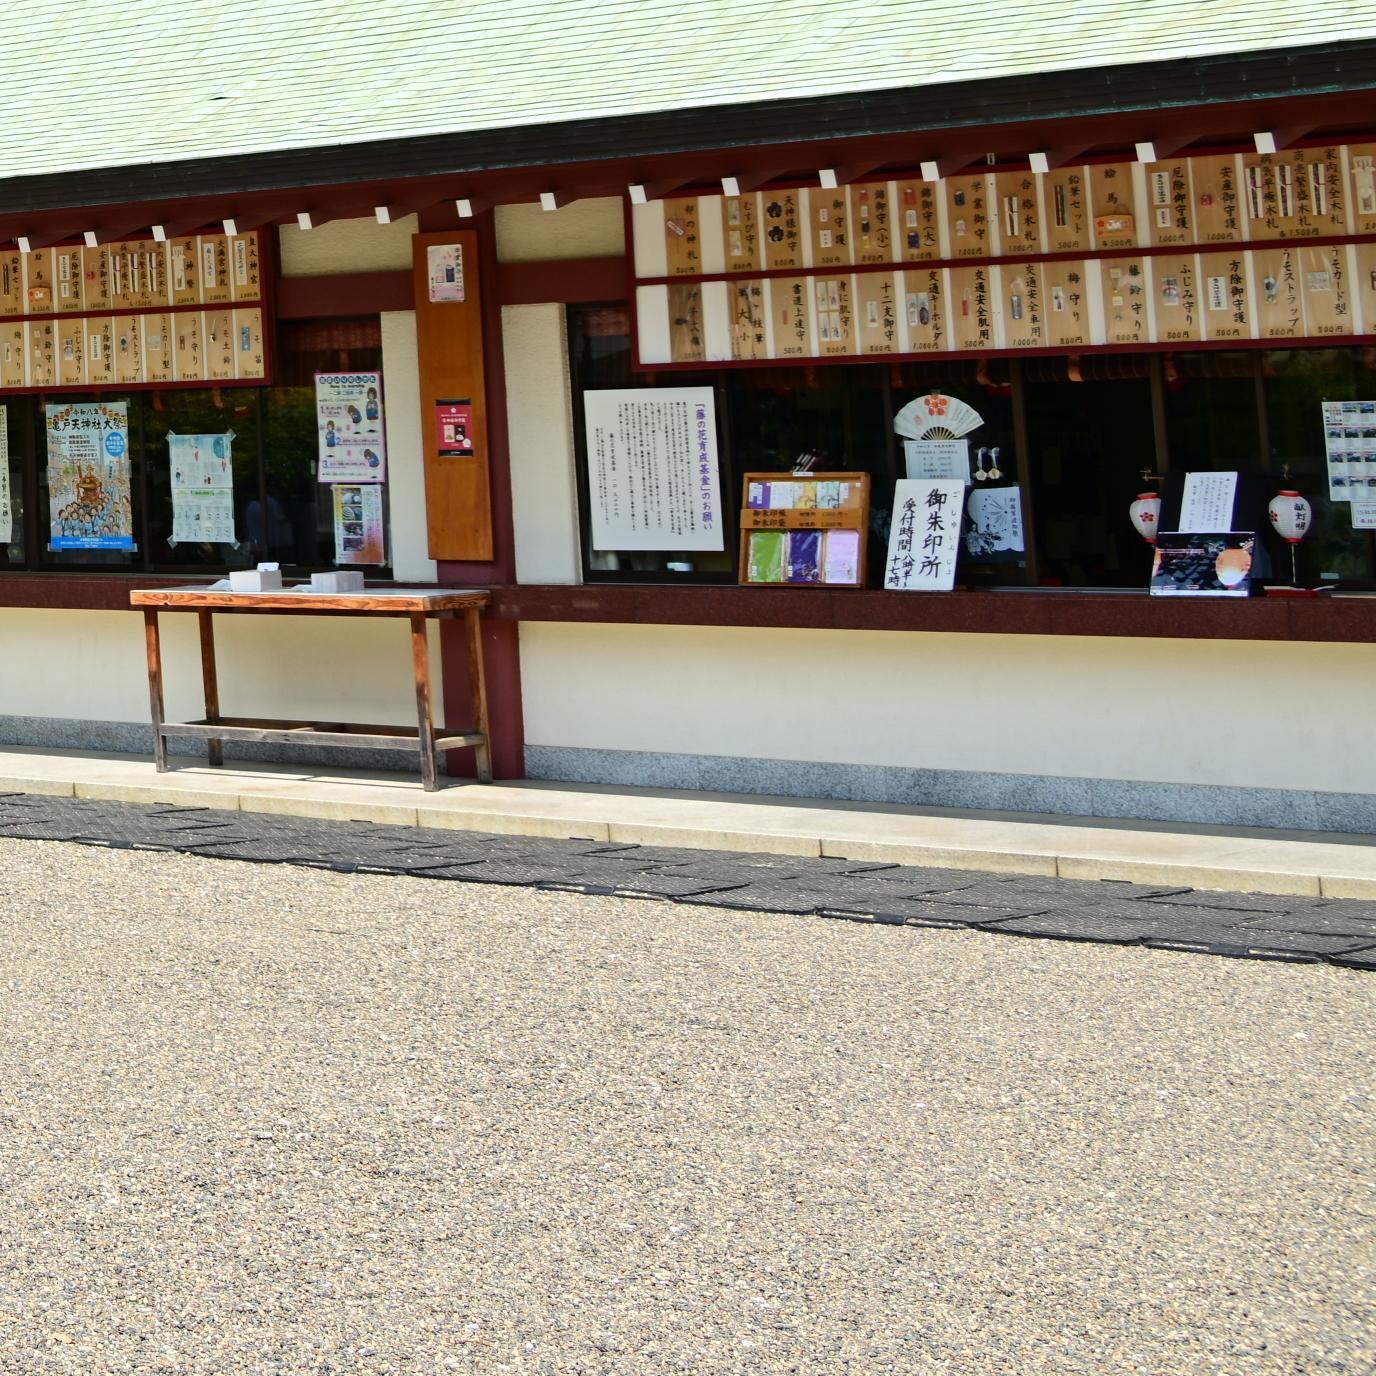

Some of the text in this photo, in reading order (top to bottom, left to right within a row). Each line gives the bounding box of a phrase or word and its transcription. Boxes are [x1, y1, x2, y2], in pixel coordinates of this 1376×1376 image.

[52, 417, 123, 432] 亀戸天神社大祭
[919, 488, 947, 579] 御朱印所
